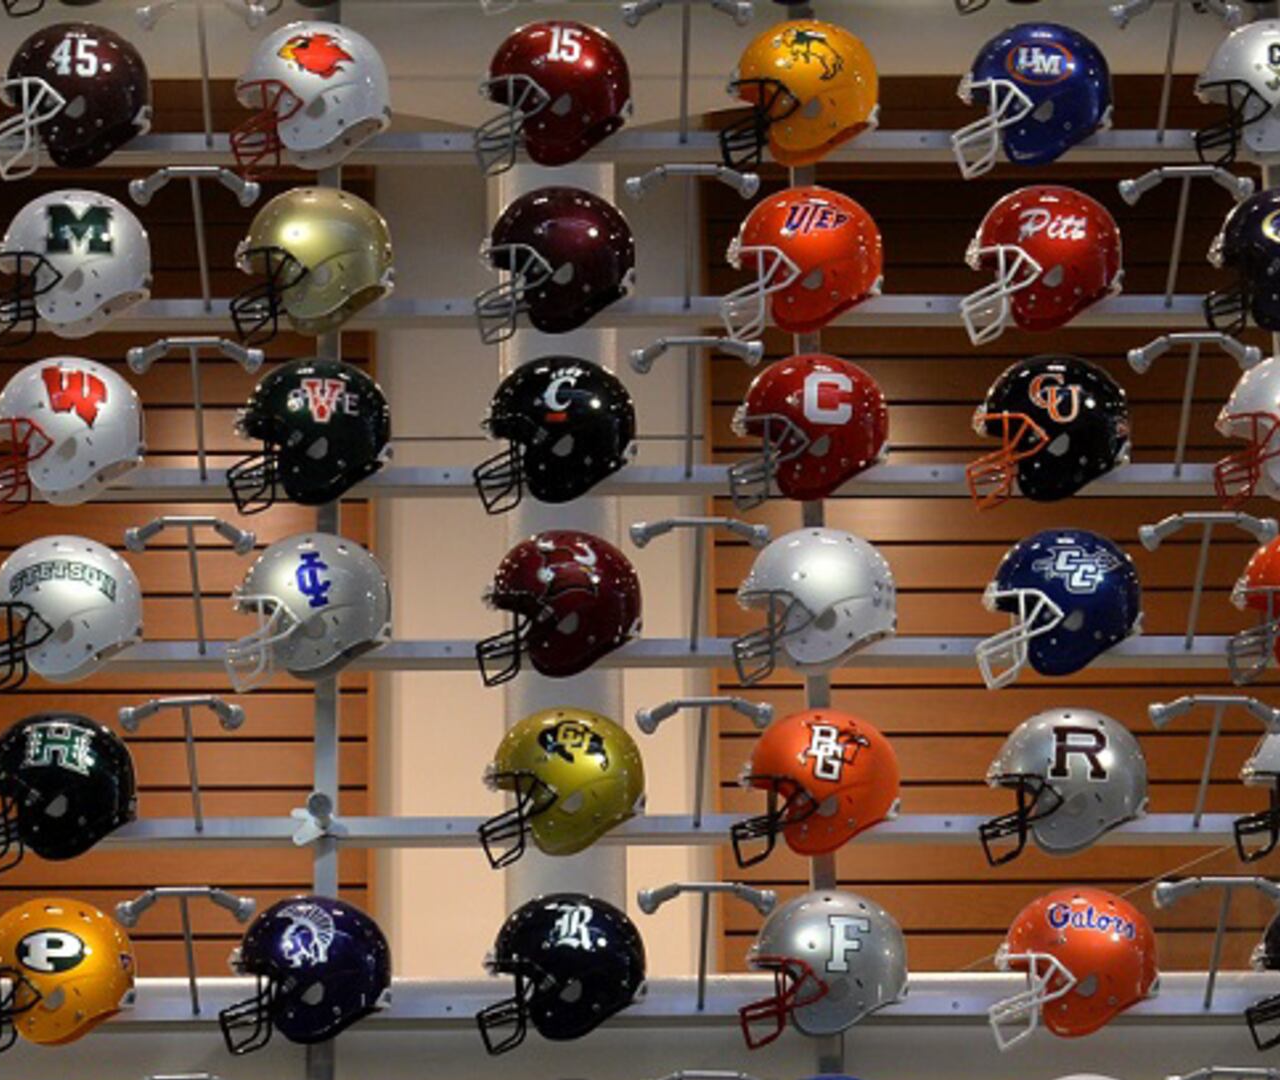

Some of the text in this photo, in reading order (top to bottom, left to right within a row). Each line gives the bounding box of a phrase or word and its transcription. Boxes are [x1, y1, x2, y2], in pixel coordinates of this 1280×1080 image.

[50, 39, 99, 76] 45
[549, 28, 581, 60] 15
[47, 204, 113, 254] M
[785, 203, 848, 232] UTEP
[1018, 209, 1086, 239] Pitt
[42, 367, 106, 429] W
[300, 379, 344, 422] V
[543, 376, 577, 411] C
[804, 373, 852, 424] C
[10, 560, 116, 603] STETSON
[1055, 548, 1102, 593] CC
[24, 725, 91, 773] H
[809, 722, 844, 781] BG
[1050, 726, 1106, 781] R
[547, 905, 593, 949] R
[1047, 904, 1137, 939] Gators
[20, 931, 73, 971] P
[826, 915, 869, 972] F
